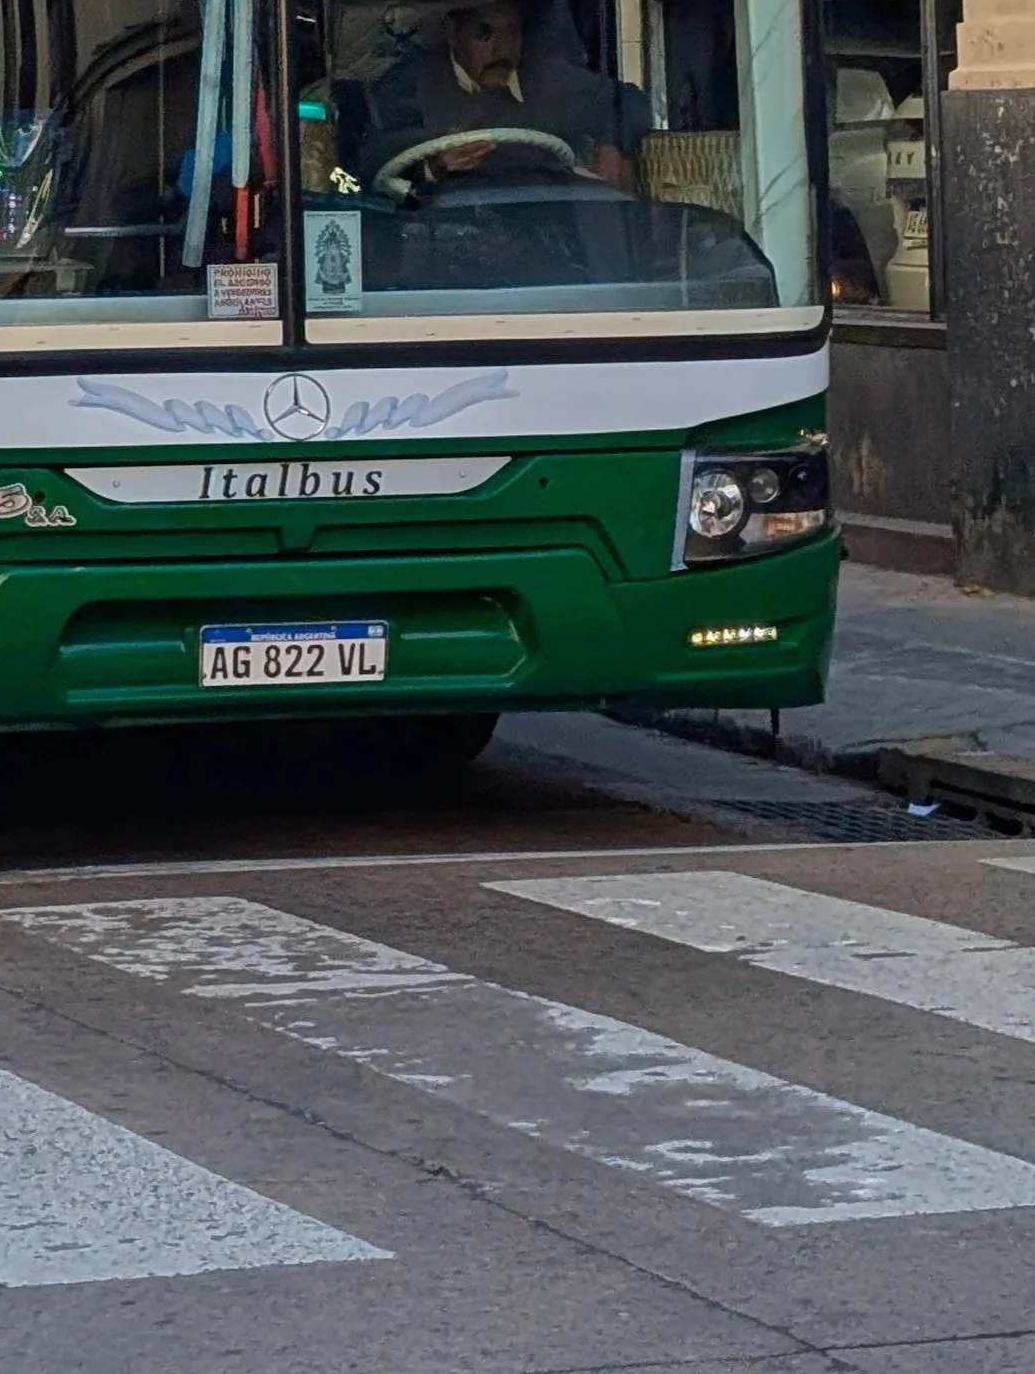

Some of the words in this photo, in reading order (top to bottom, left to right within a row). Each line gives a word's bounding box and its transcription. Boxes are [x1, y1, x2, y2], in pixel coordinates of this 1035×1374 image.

[198, 462, 383, 499] Italbus
[210, 645, 251, 679] AG
[263, 644, 325, 678] 822
[337, 642, 377, 676] VL
